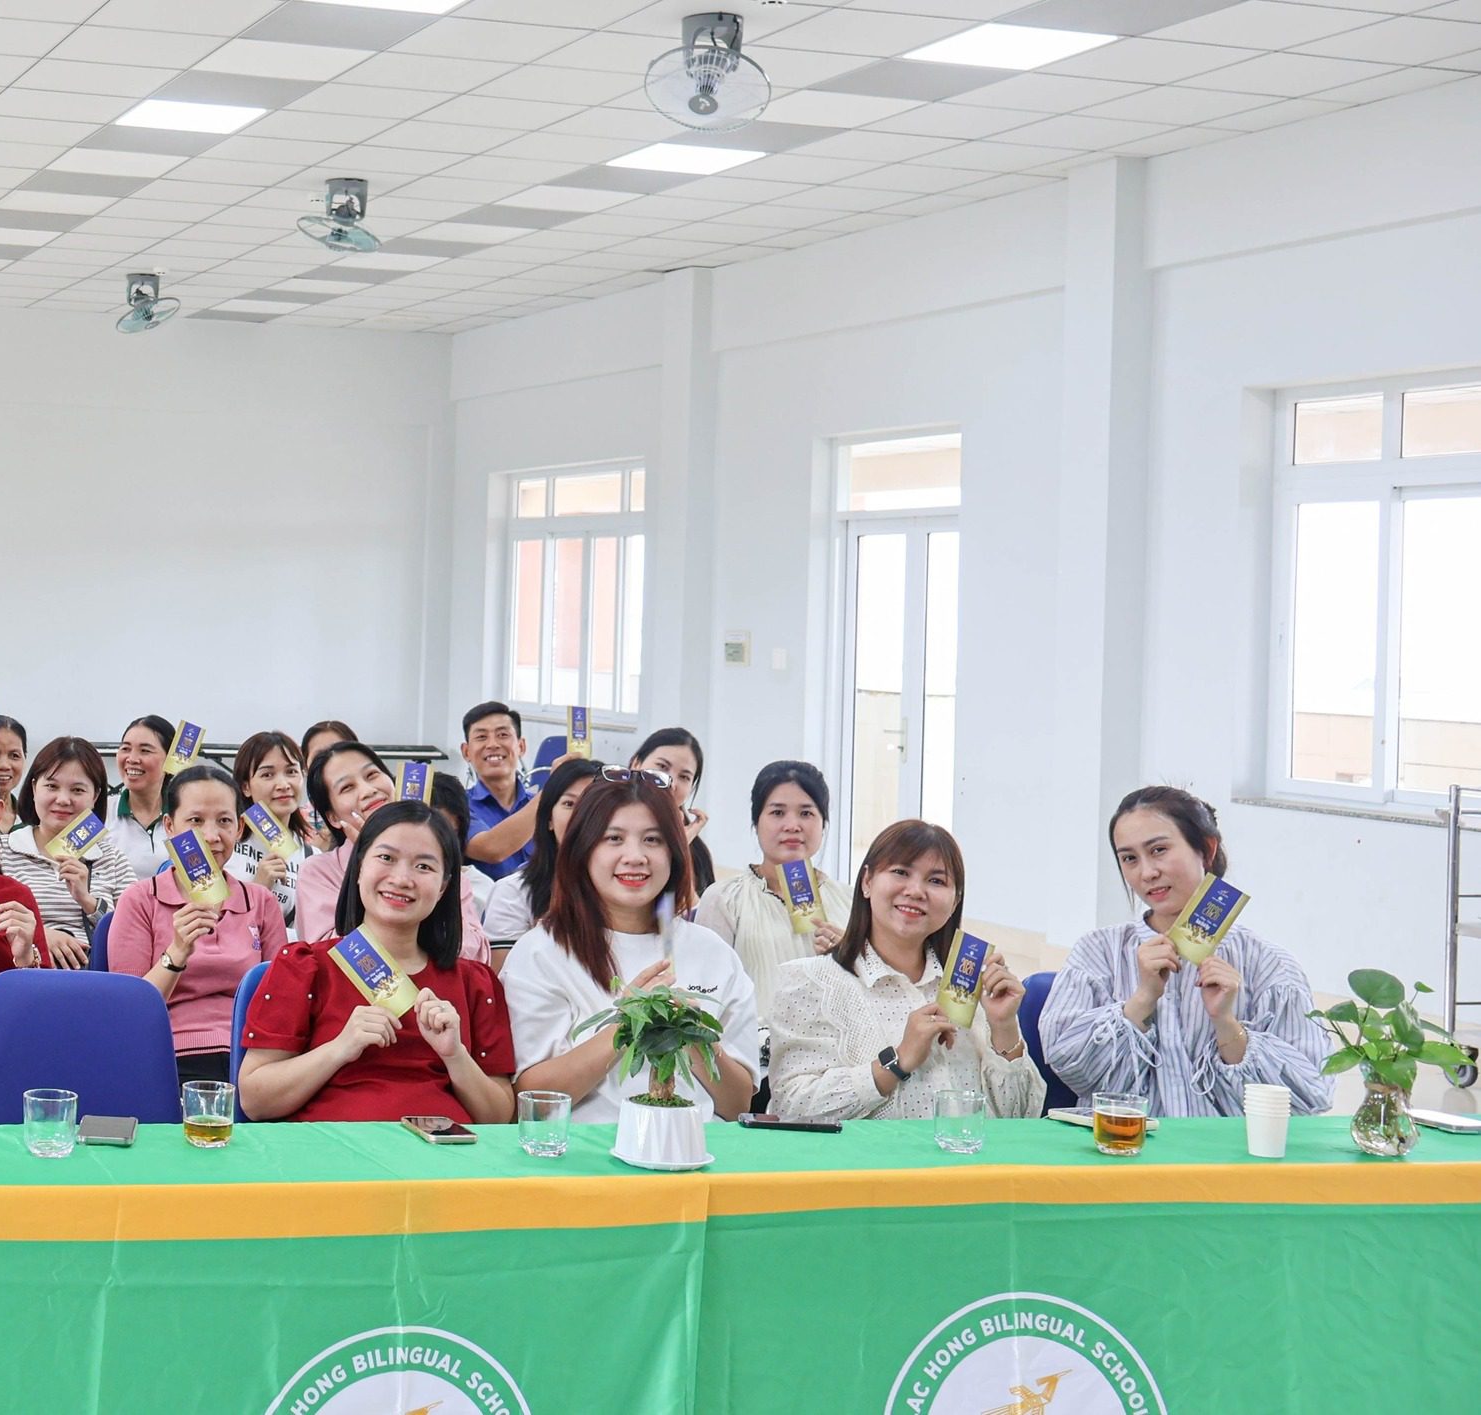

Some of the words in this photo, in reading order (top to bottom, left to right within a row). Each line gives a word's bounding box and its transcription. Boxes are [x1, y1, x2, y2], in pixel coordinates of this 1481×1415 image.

[290, 1364, 347, 1415] HONG
[352, 1346, 461, 1379] BILINGUAL
[906, 1381, 930, 1415] AC
[923, 1328, 977, 1381] HONG
[979, 1311, 1085, 1349] BILINGUAL
